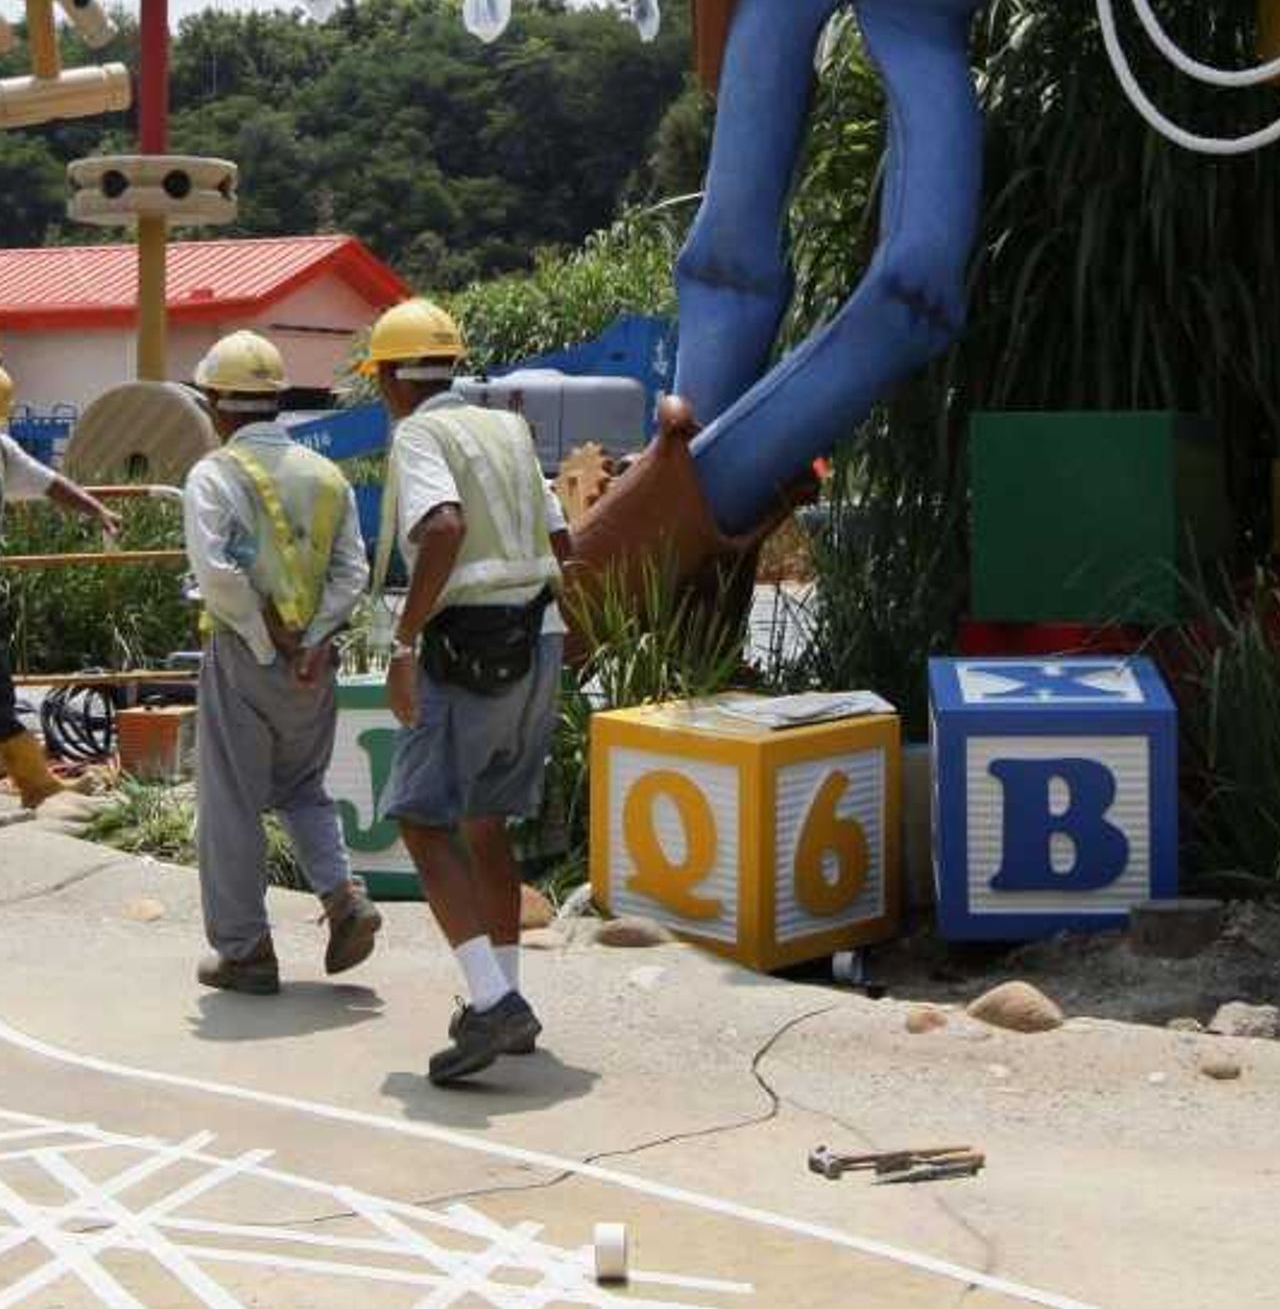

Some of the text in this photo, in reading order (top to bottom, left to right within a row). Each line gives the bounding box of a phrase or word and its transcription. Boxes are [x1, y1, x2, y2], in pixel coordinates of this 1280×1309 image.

[623, 769, 721, 920] Q
[793, 769, 870, 918] 6
[987, 757, 1130, 892] B
